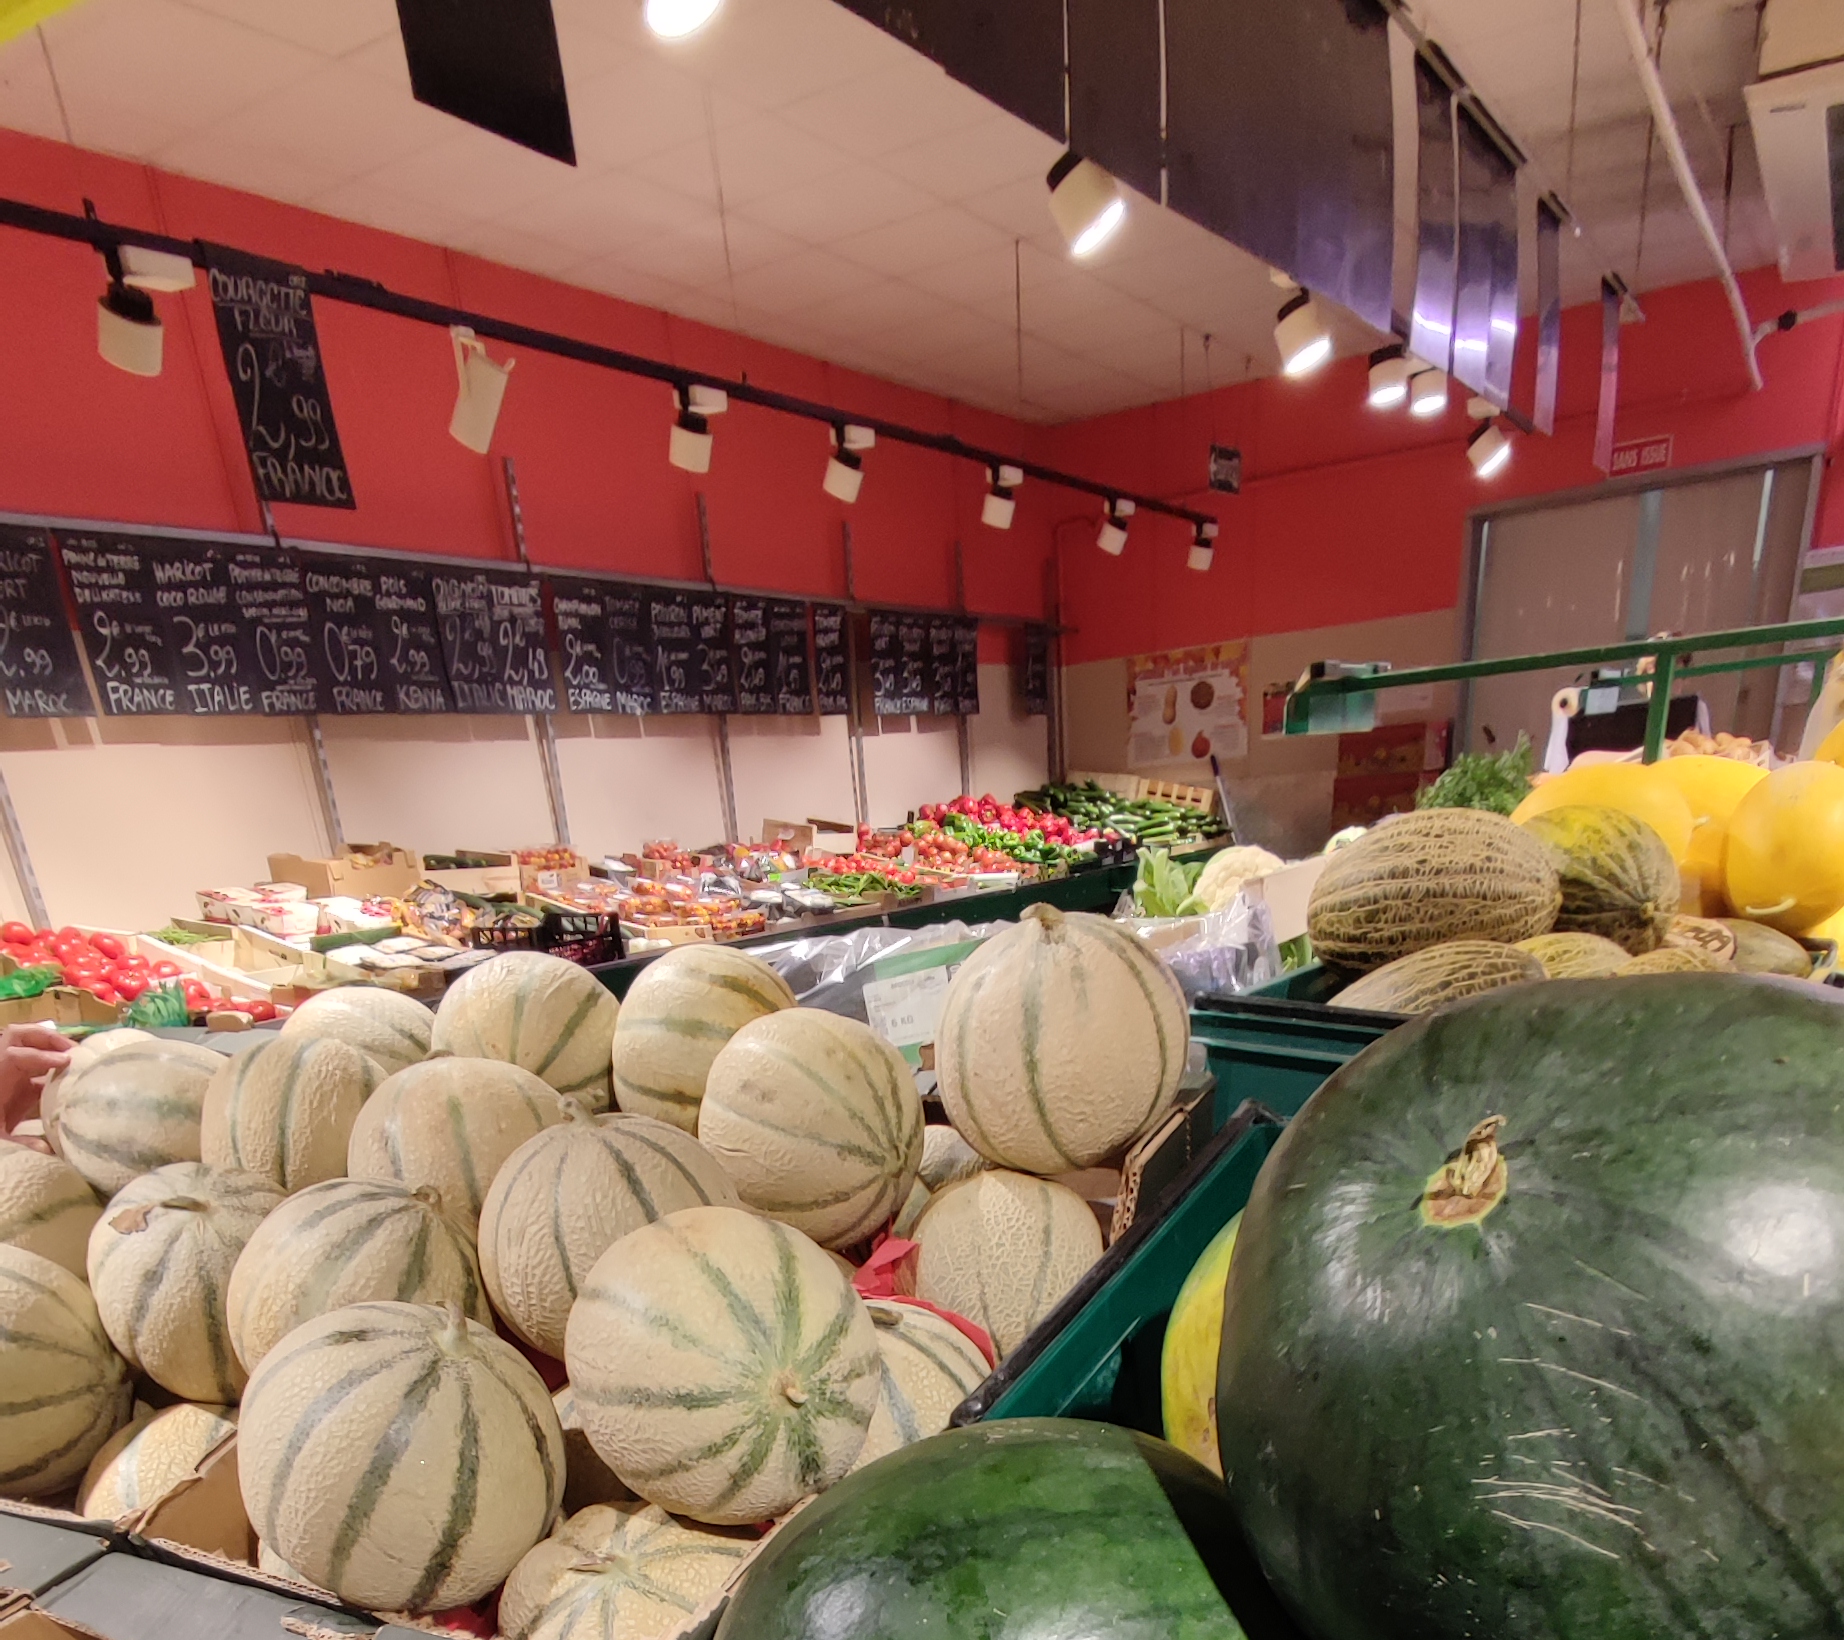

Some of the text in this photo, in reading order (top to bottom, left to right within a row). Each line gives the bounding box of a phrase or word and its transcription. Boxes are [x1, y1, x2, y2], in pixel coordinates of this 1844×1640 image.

[252, 452, 346, 499] FRANCE
[153, 559, 213, 584] HARICOT
[306, 571, 373, 596] CONCOMBRE
[156, 591, 184, 606] COCO
[5, 688, 70, 714] MAROC
[106, 681, 176, 713] FRANCE
[261, 689, 317, 713] FRANCE
[332, 686, 384, 712] FRANCE
[397, 684, 446, 711] KENYA
[506, 684, 555, 710] MAROC
[568, 689, 612, 710] ESPAGNE
